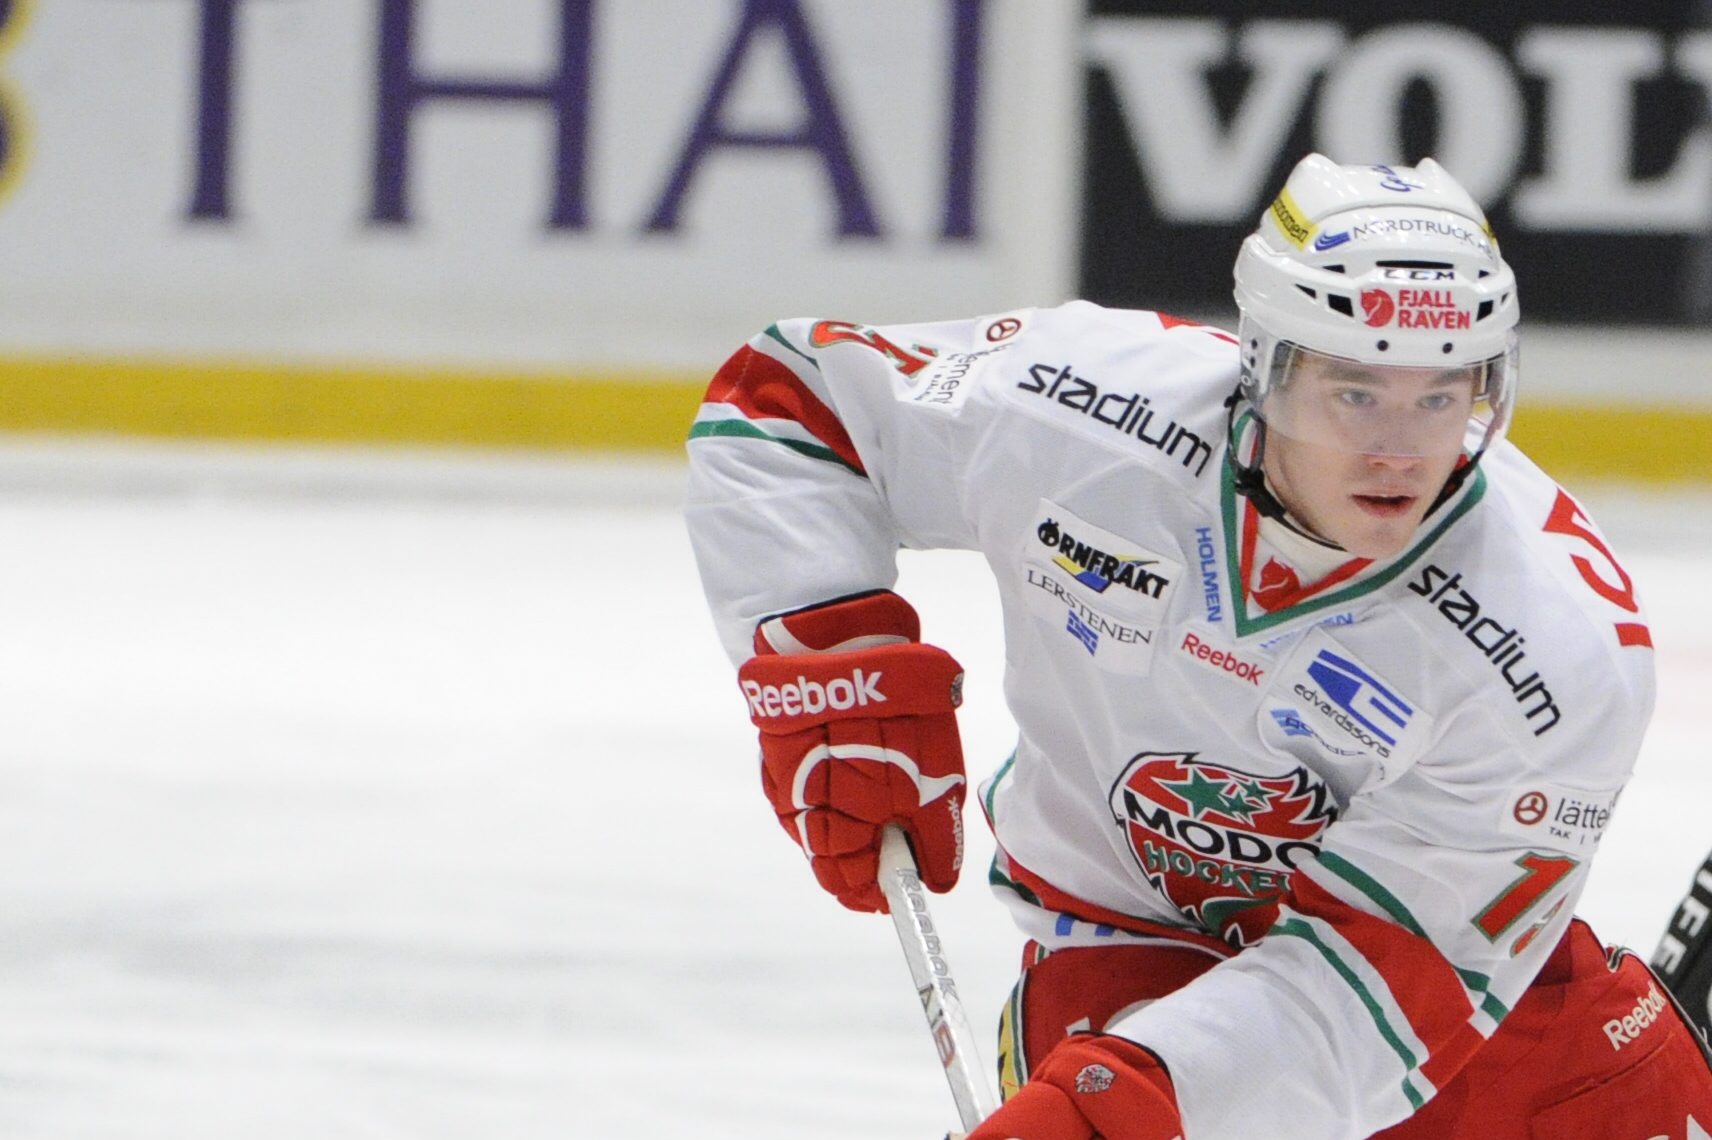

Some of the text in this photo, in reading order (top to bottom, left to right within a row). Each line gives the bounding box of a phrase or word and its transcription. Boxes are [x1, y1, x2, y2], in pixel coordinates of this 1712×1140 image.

[1384, 269, 1455, 281] CCM
[1018, 362, 1212, 478] stadium
[1027, 570, 1153, 645] LERSTENEN
[1195, 527, 1222, 622] HOLMEN
[1181, 632, 1264, 687] Reebok
[1408, 563, 1562, 738] stadium
[742, 667, 888, 721] Reebok
[1293, 683, 1391, 759] edvardssons
[1602, 979, 1667, 1052] Reebok
